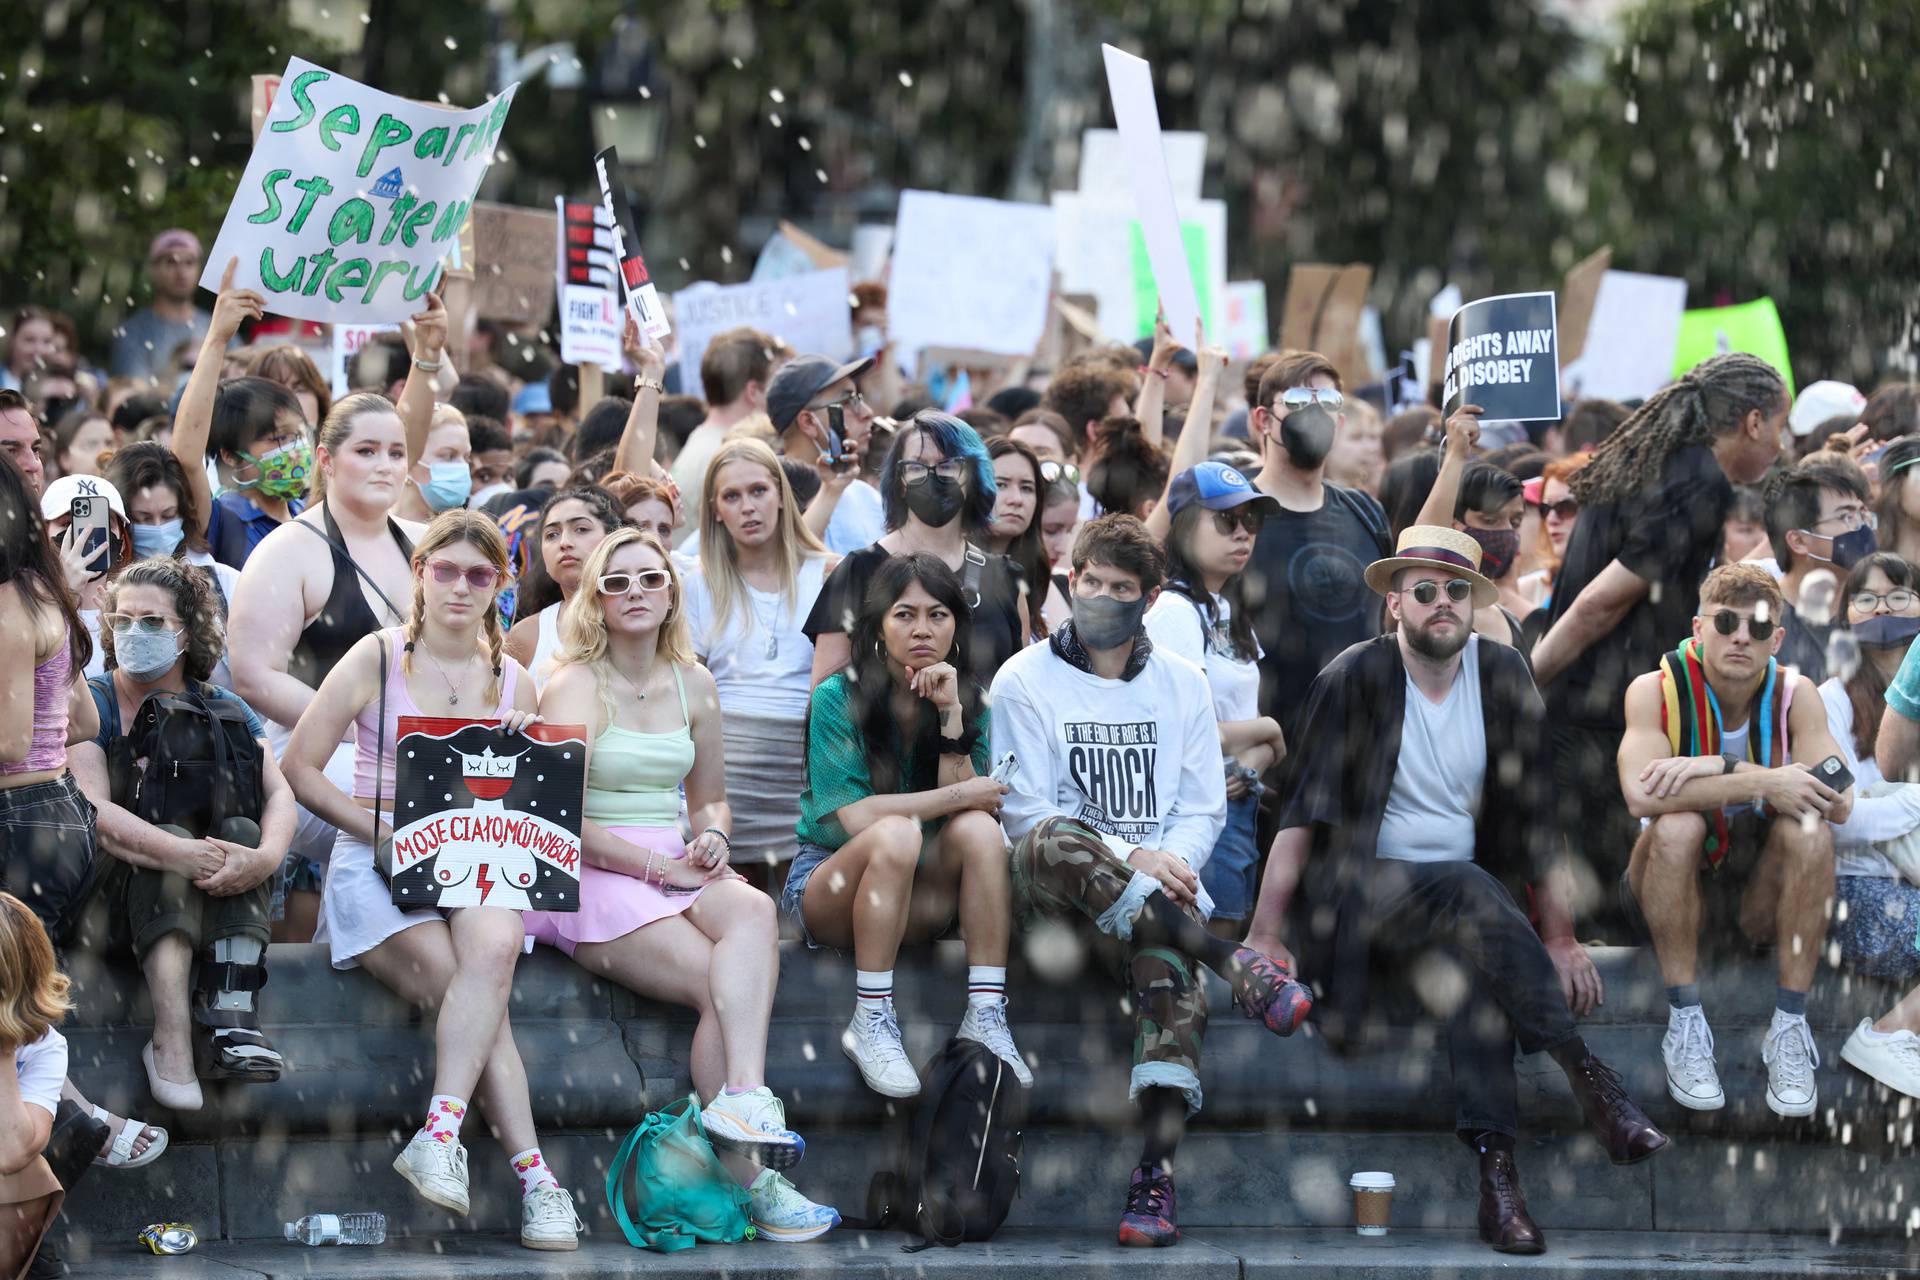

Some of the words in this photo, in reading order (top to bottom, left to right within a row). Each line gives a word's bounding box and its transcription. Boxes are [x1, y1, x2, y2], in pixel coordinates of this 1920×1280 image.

[260, 246, 440, 304] uteru
[1452, 332, 1503, 369] RIGHTS
[1506, 329, 1552, 355] AWAY
[1460, 359, 1533, 390] DISOBEY
[1065, 723, 1075, 742] IF
[1075, 723, 1094, 742] THE
[1093, 724, 1110, 743] END
[1109, 725, 1120, 744] OF
[1120, 724, 1139, 744] ROE
[1139, 723, 1150, 743] IS
[1150, 723, 1157, 742] A
[1069, 746, 1157, 819] SHOCK
[394, 818, 449, 865] MOJE
[533, 826, 580, 872] WYBÓR
[1080, 815, 1116, 835] PAYING
